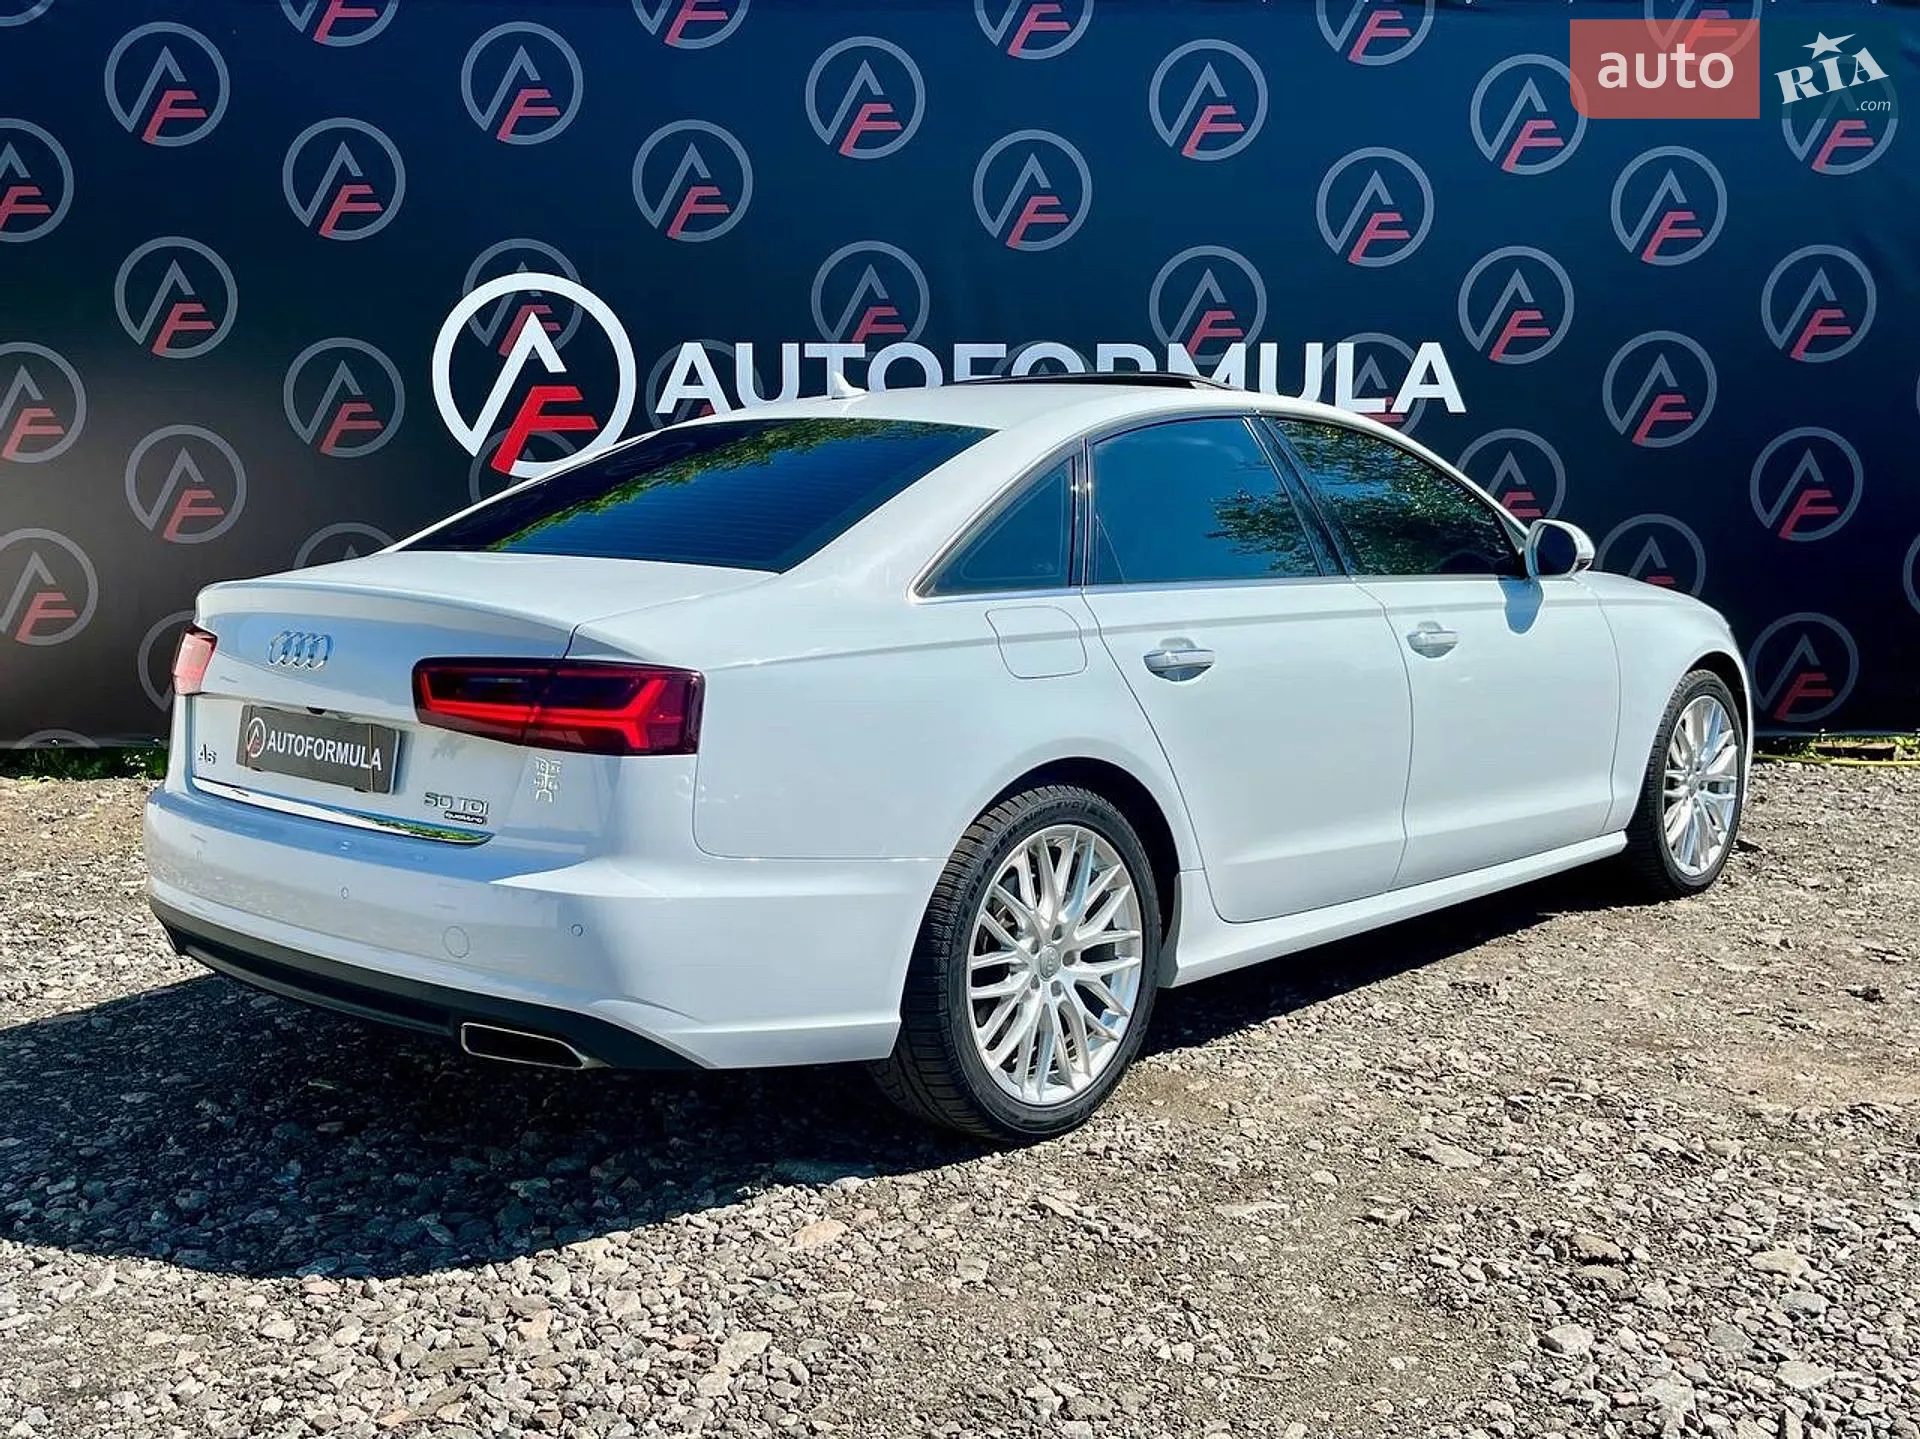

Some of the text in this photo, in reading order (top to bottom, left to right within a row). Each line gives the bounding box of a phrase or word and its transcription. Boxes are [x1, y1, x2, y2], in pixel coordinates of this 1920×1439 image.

[267, 730, 382, 771] AUTOFORMULA
[457, 797, 489, 815] TDI
[445, 812, 485, 824] quattro
